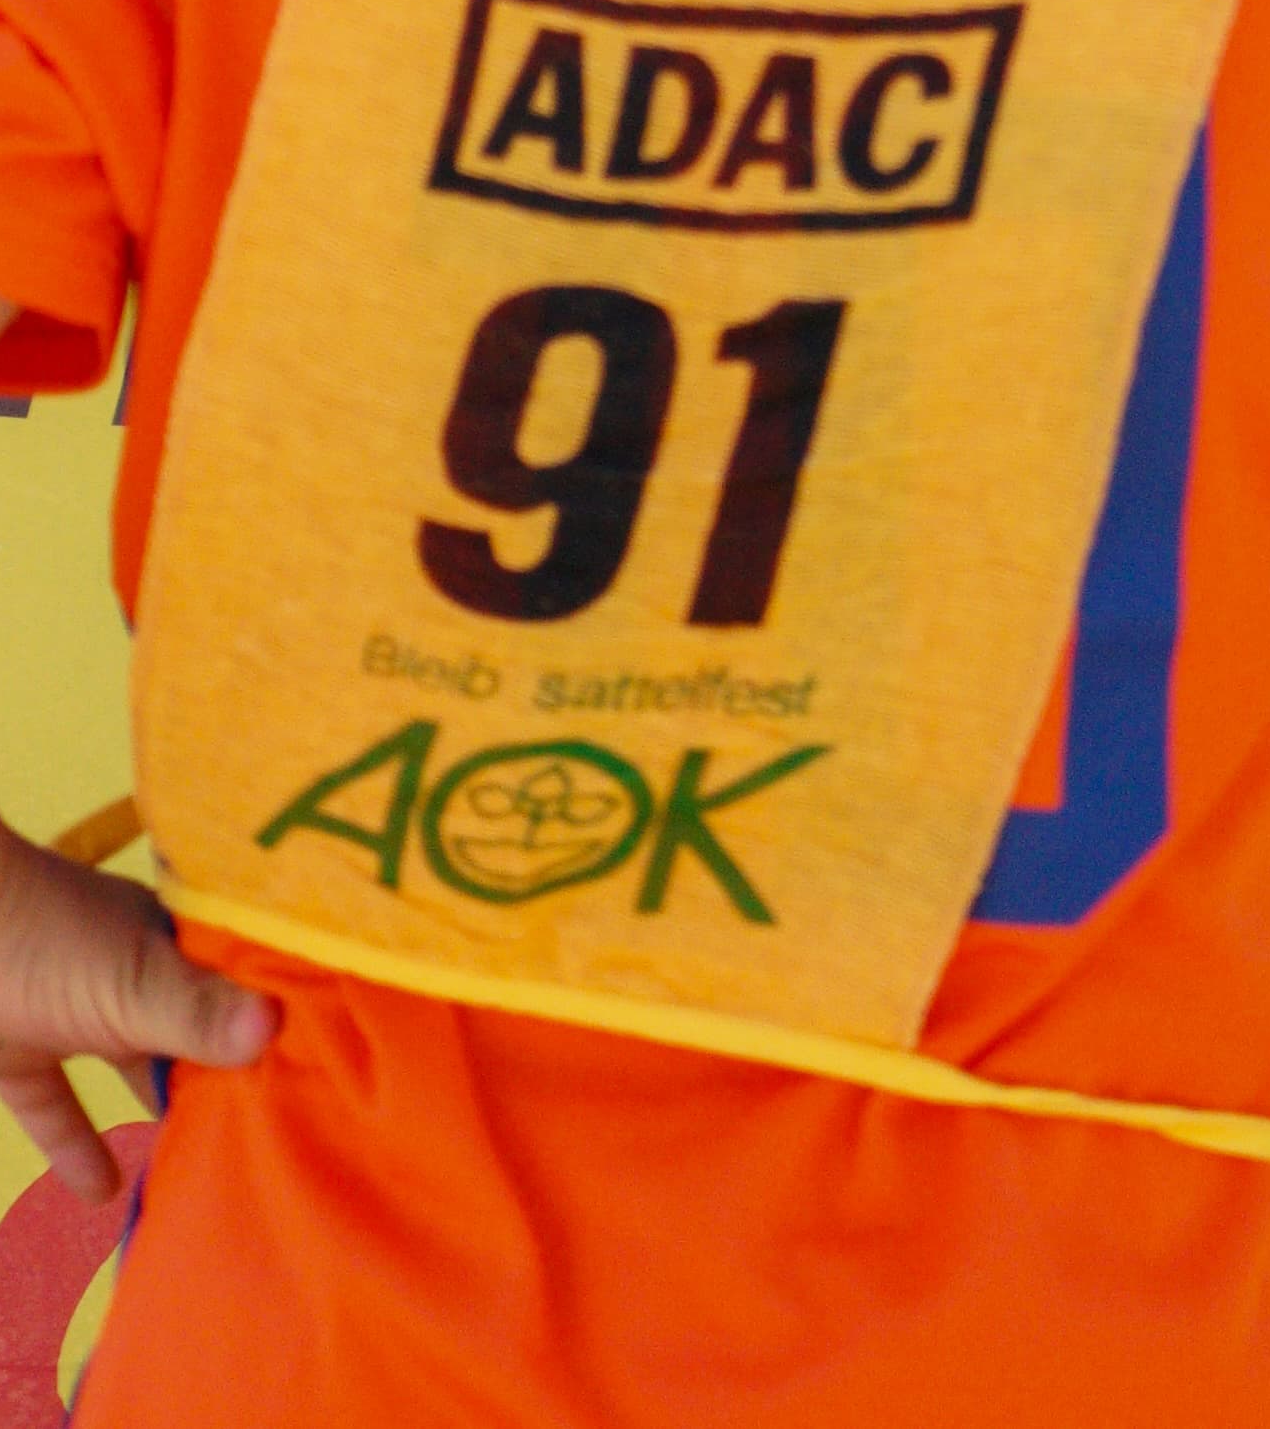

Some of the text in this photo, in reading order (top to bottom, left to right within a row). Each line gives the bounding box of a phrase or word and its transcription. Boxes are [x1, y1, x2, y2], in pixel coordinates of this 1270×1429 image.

[478, 26, 954, 195] ADAC
[413, 282, 852, 628] 91
[253, 714, 836, 927] AOK
